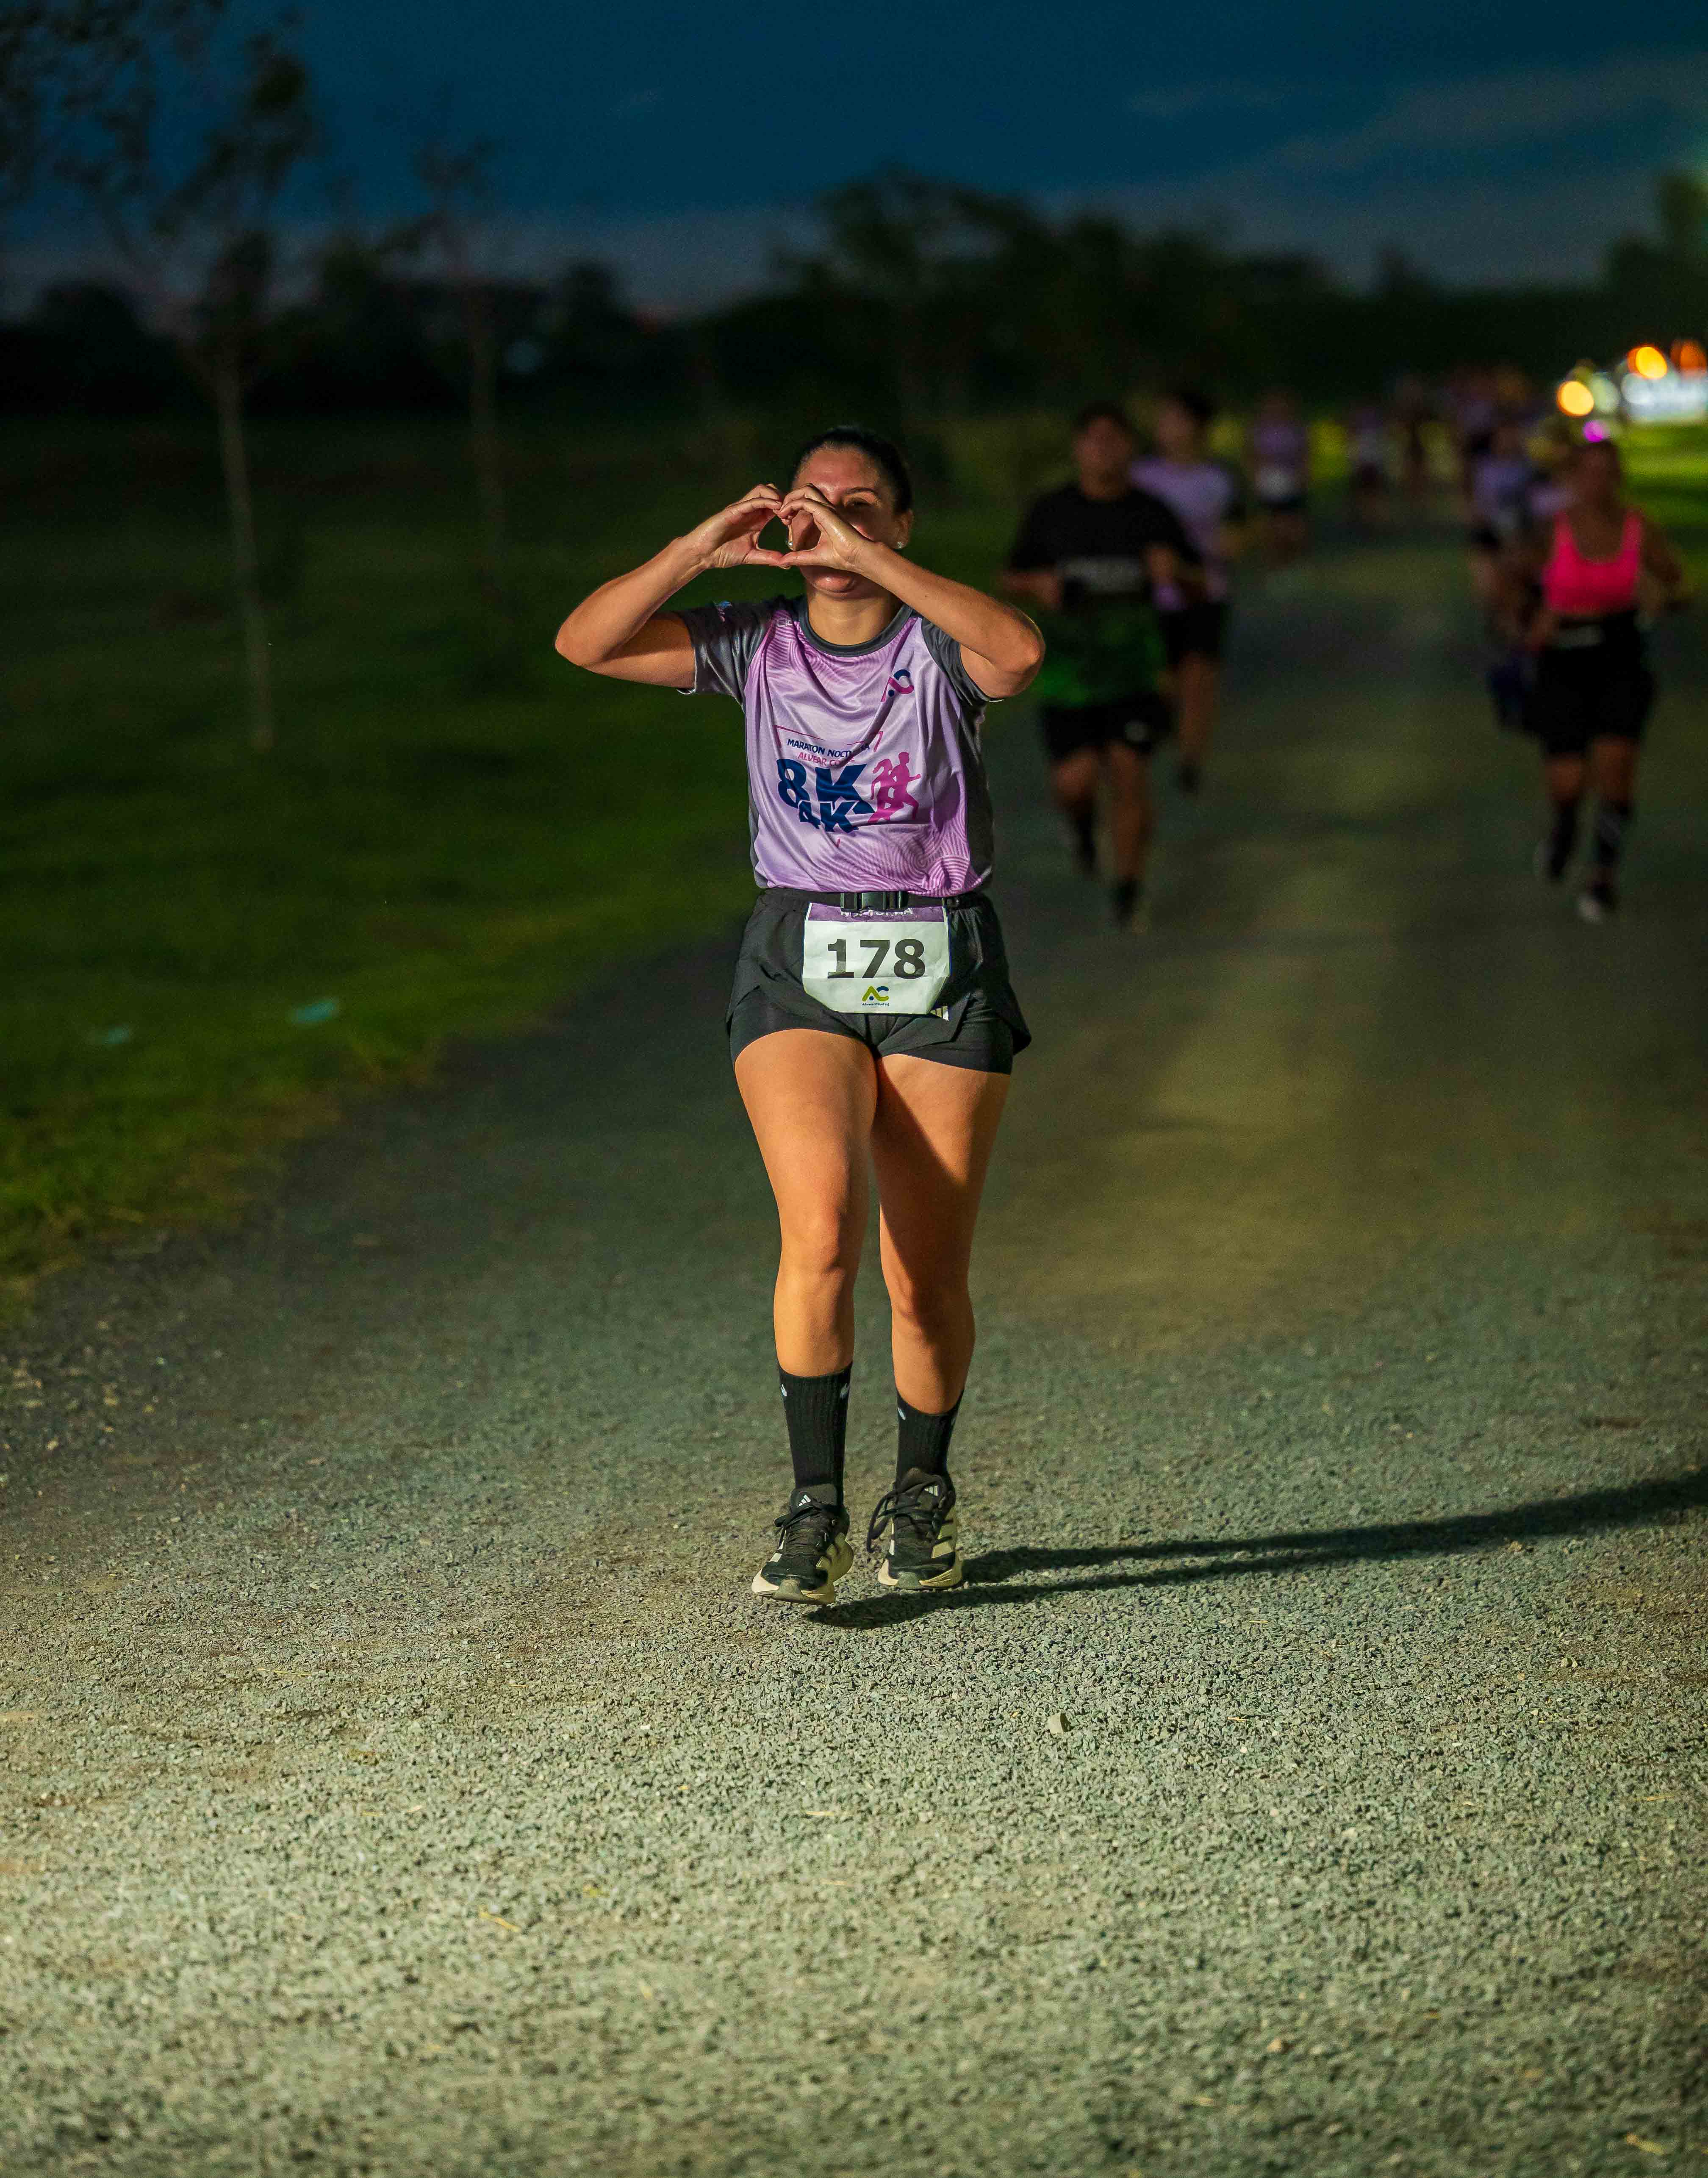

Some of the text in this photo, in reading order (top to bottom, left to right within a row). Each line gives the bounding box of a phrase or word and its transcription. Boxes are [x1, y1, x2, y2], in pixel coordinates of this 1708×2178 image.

[787, 738, 825, 755] MARATON
[798, 752, 826, 766] ALVEAR
[776, 759, 876, 814] 8K
[799, 801, 859, 833] 4K
[827, 938, 925, 979] 178
